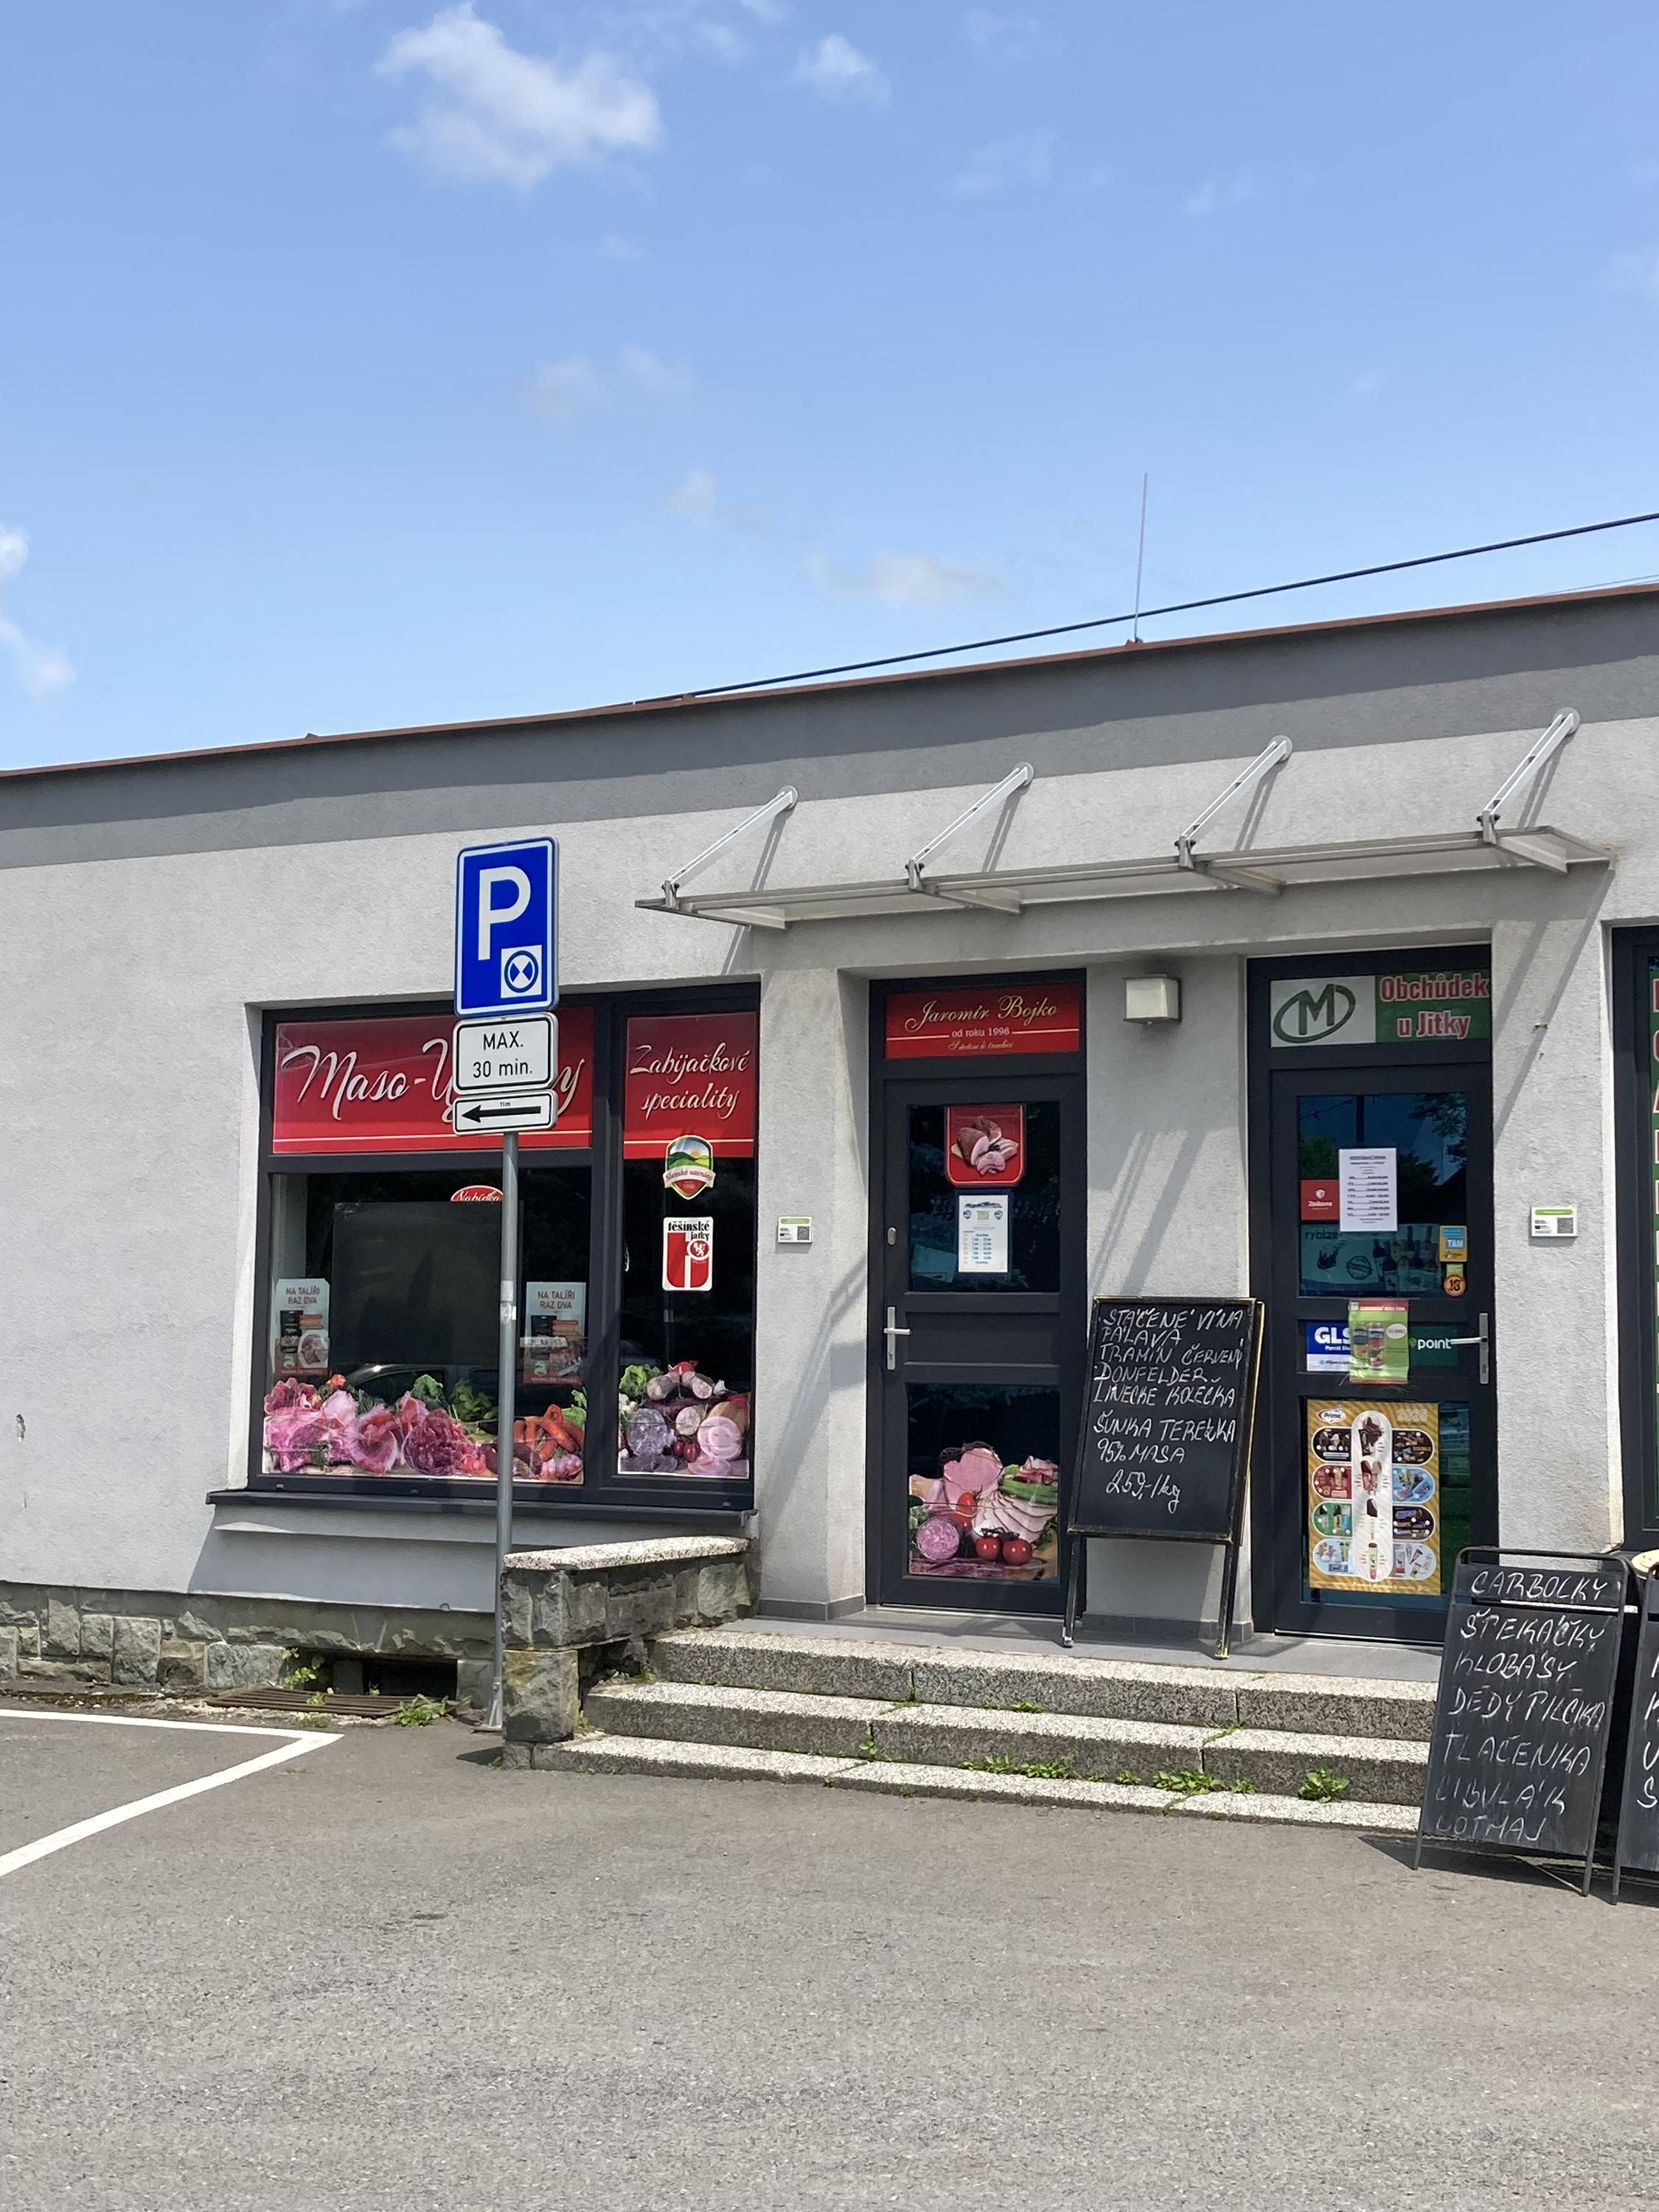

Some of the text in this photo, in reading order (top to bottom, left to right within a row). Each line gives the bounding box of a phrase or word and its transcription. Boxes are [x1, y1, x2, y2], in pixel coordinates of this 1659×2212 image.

[479, 866, 531, 961] P
[1380, 973, 1489, 1002] Obchůdek
[905, 995, 1059, 1032] Jaromír Bojko
[951, 1027, 1010, 1038] od roku 1998
[1397, 1010, 1471, 1040] u Jitky
[483, 1030, 524, 1051] MAX.
[473, 1058, 533, 1078] 30 min.
[630, 1042, 751, 1085] Zabijačkové
[641, 1082, 740, 1121] speciality
[285, 1287, 296, 1295] NA
[288, 1296, 302, 1304] RAZ
[538, 1290, 575, 1300] NA TALÍŘI
[540, 1301, 572, 1310] RAZ DVA
[1417, 1337, 1452, 1350] point
[1093, 1409, 1152, 1439] ŠUNKA
[1128, 1443, 1186, 1464] MASA
